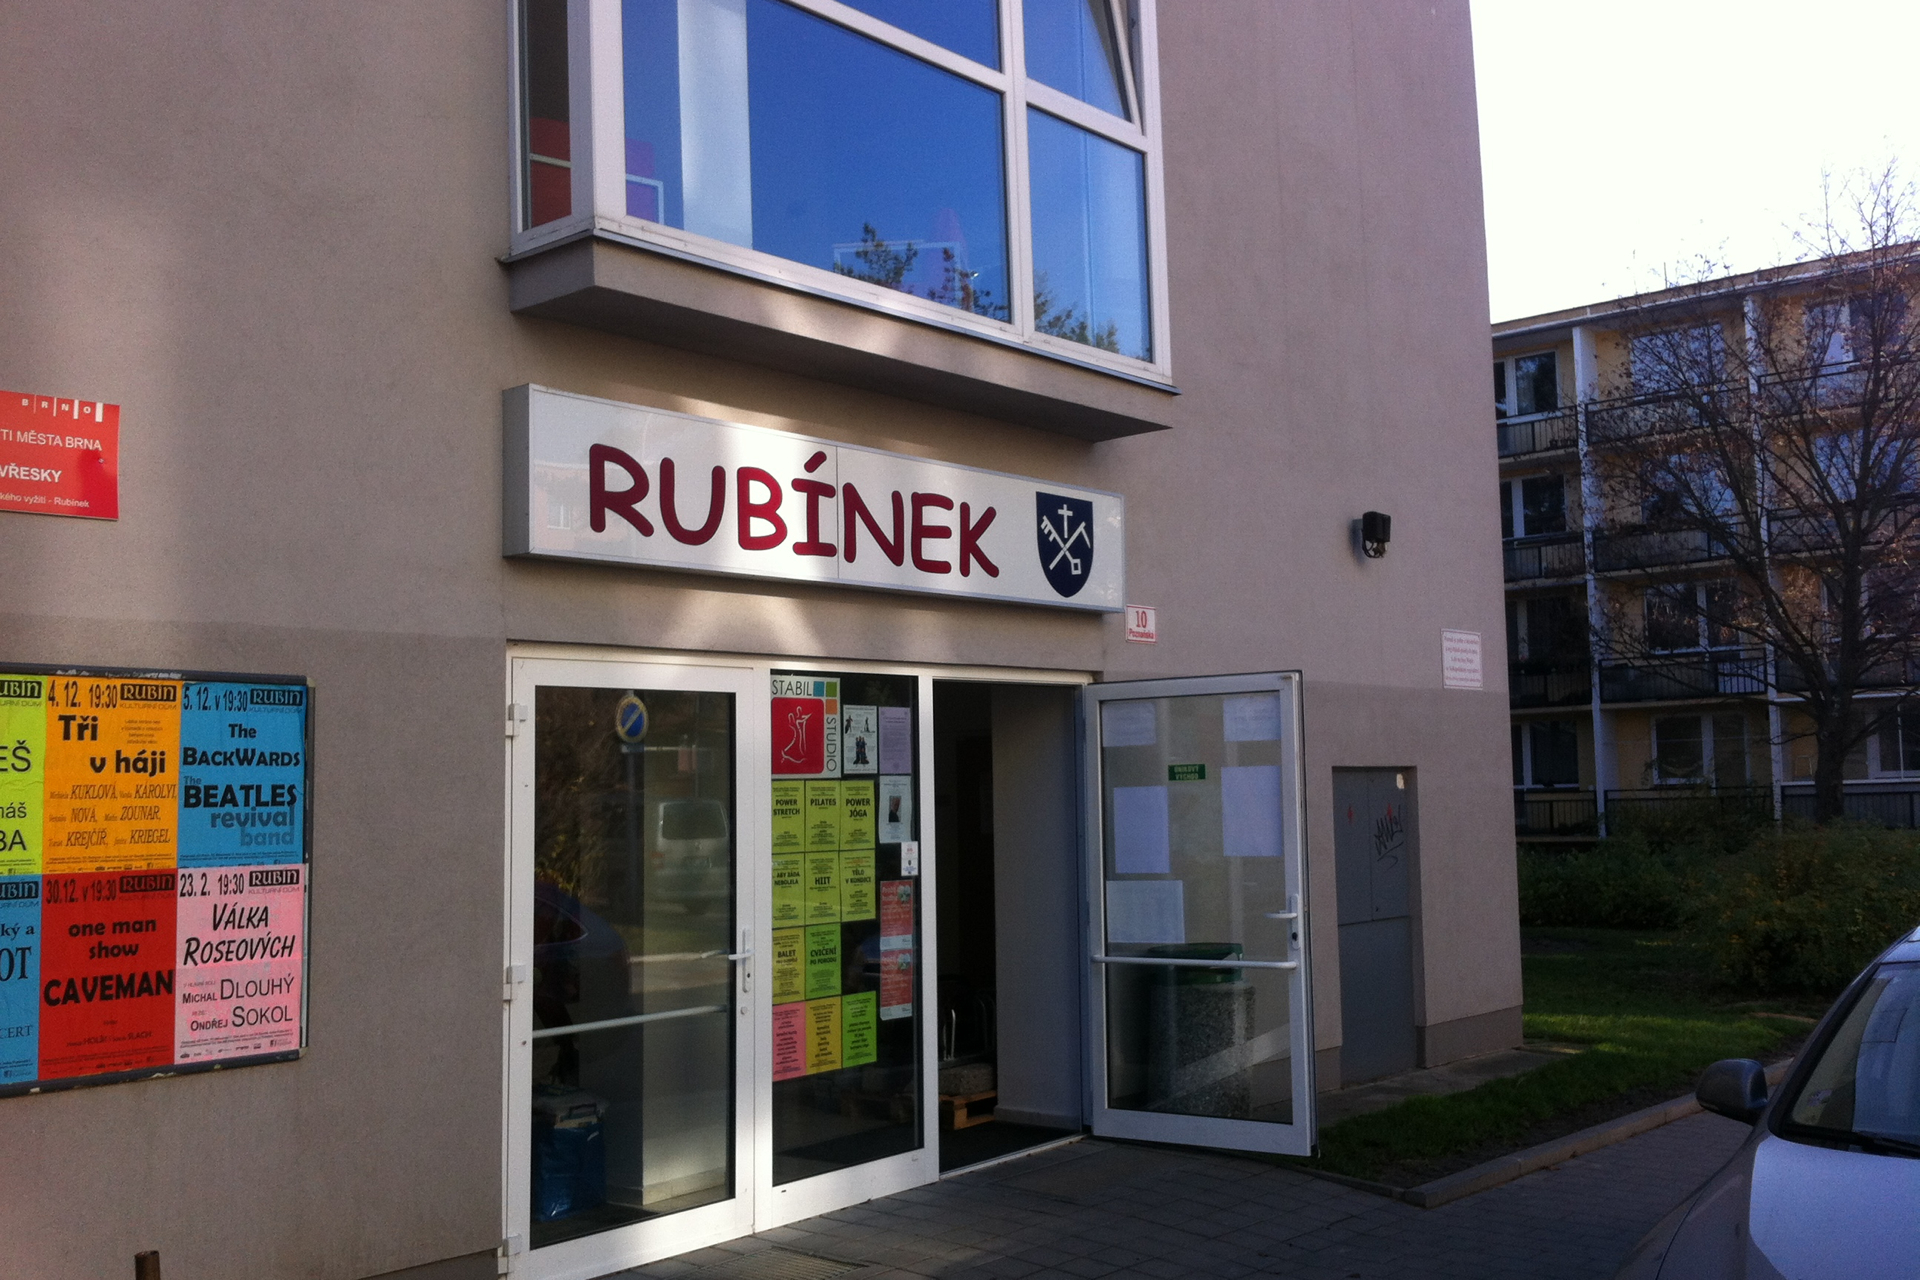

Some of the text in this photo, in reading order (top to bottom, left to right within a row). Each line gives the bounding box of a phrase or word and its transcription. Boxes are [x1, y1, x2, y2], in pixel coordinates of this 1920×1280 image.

[16, 430, 63, 447] MĚSTA
[65, 436, 102, 451] BRNA
[588, 442, 1001, 578] RUBÍNEK
[1135, 610, 1148, 629] 10
[48, 679, 118, 710] 4. 12. 19:30
[771, 679, 812, 698] STABIL
[183, 686, 248, 713] 5. 12. v 19:30
[57, 714, 99, 741] Tři
[228, 723, 258, 739] The
[825, 716, 838, 773] STUDIO
[89, 749, 166, 778] v háji
[183, 775, 203, 786] The
[183, 784, 298, 809] BEATLES
[775, 798, 798, 807] POWER
[810, 798, 837, 807] PILATES
[845, 798, 871, 807] POWER
[209, 804, 296, 829] revival
[773, 807, 801, 817] STRETCH
[849, 807, 868, 818] JÓGA
[239, 826, 295, 847] band
[91, 878, 118, 902] 19:30
[179, 872, 245, 898] 23. 2. 19:30
[814, 876, 832, 886] HIIT
[212, 902, 269, 931] VÁLKA
[25, 926, 35, 936] a
[68, 918, 158, 938] one man
[88, 940, 140, 961] show
[182, 930, 297, 967] ROSEOVÝCH
[777, 949, 797, 959] BALET
[810, 946, 837, 958] CVIČENÍ
[43, 968, 174, 1007] CAVEMAN
[231, 1004, 293, 1028] SOKOL
